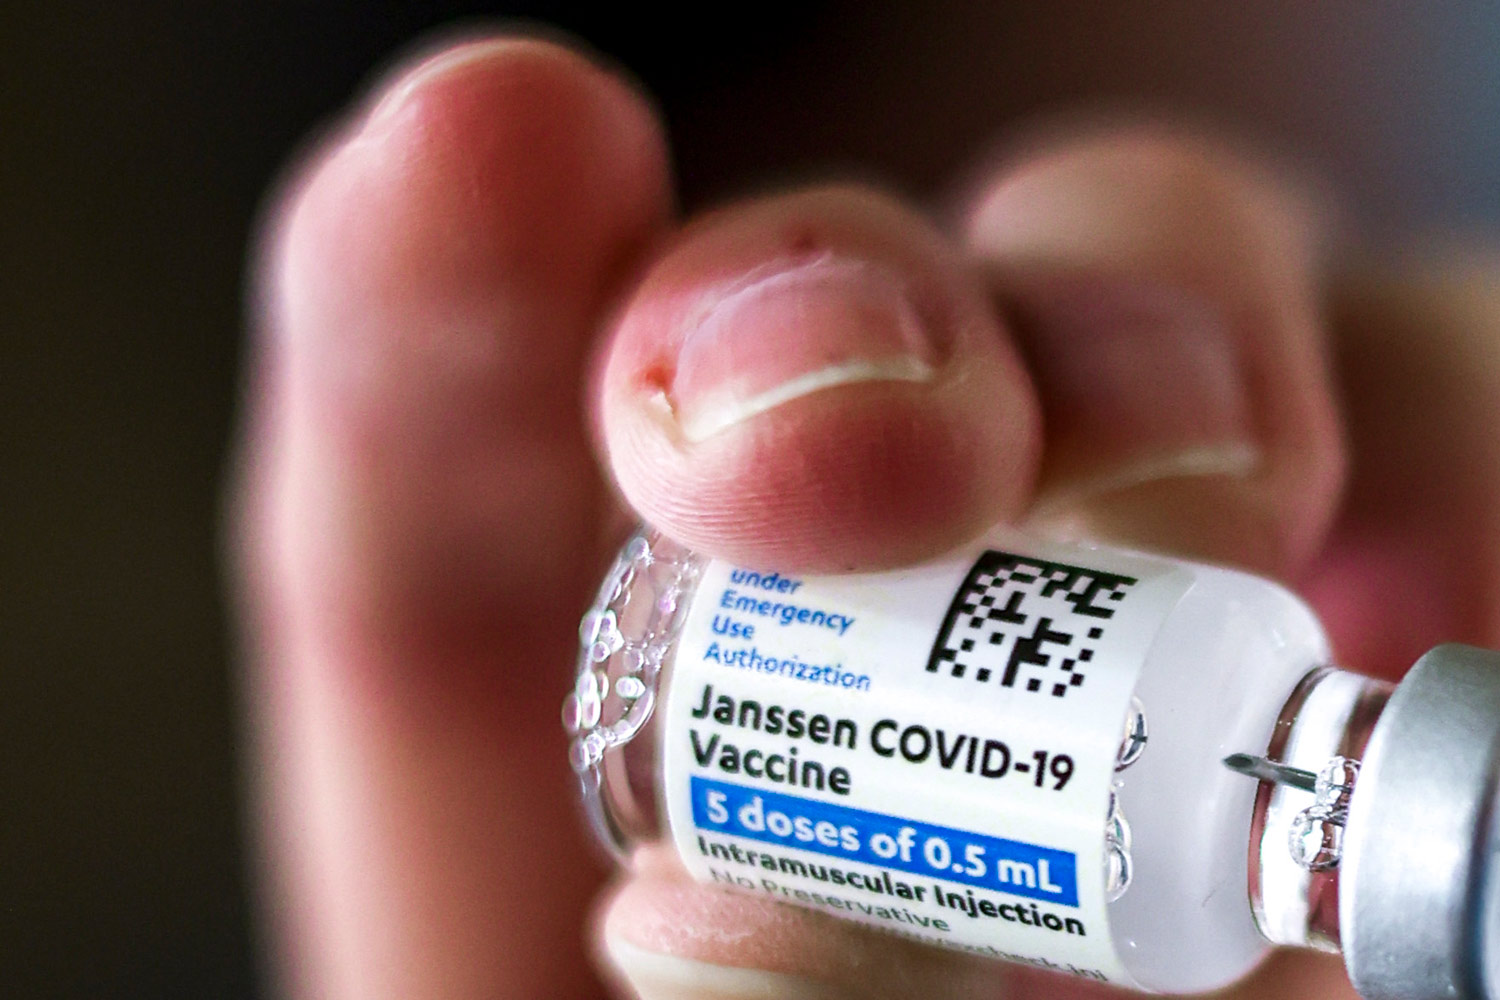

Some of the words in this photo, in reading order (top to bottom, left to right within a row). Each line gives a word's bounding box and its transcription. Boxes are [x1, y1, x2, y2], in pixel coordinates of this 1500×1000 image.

[720, 588, 855, 636] Emergency
[731, 569, 803, 595] under
[712, 614, 755, 639] Use
[703, 642, 871, 691] Authorization
[689, 729, 852, 796] Vaccine
[692, 684, 857, 749] Janssen
[870, 719, 1076, 791] COVID-19
[706, 790, 728, 823] 5
[738, 797, 861, 851] doses
[870, 827, 917, 863] of
[923, 839, 987, 878] 0.5
[999, 858, 1062, 894] mL
[698, 836, 926, 902] Intramuscular
[934, 885, 1086, 936] Injection
[709, 867, 755, 890] No
[761, 878, 951, 932] Preservative
